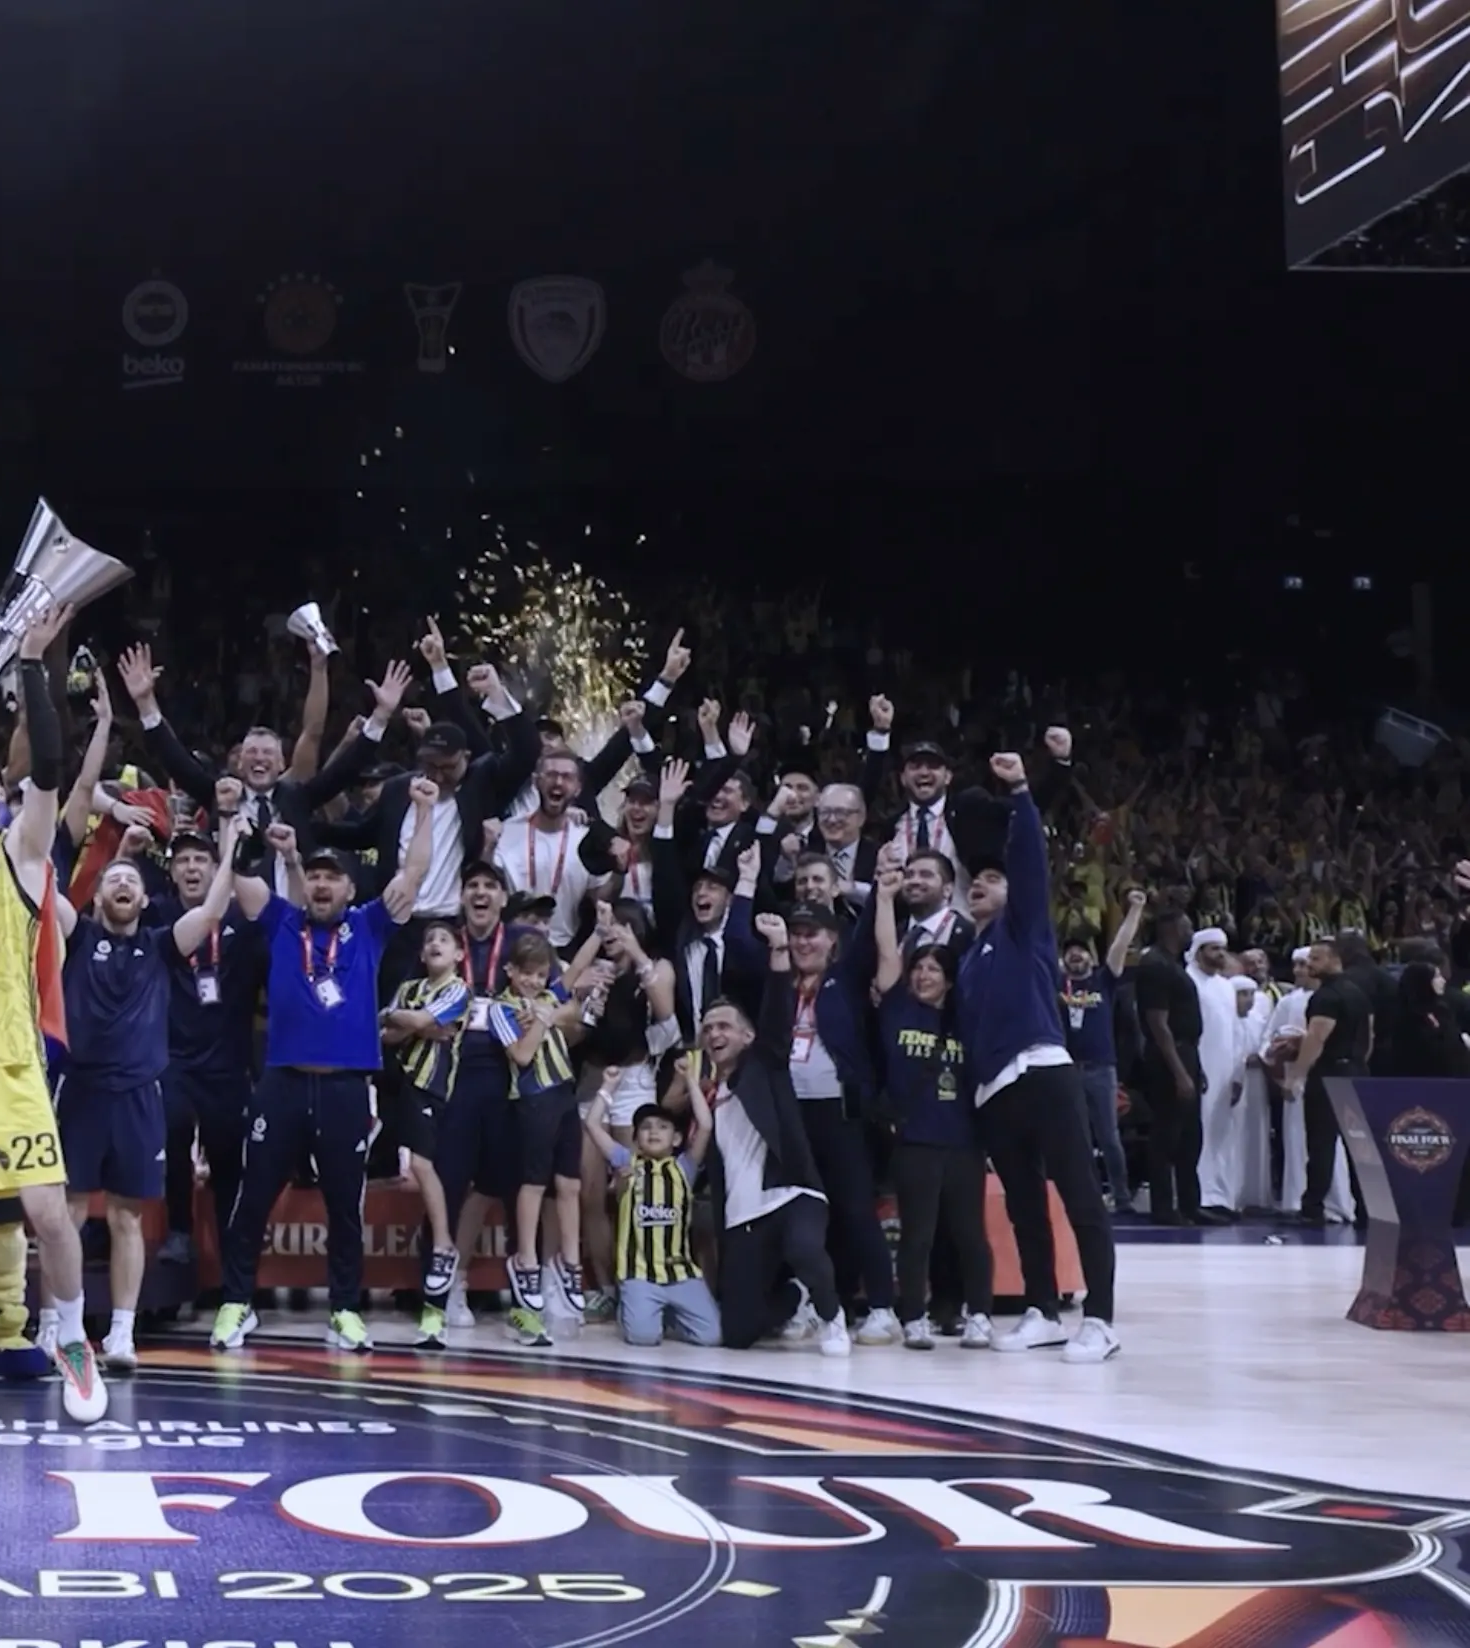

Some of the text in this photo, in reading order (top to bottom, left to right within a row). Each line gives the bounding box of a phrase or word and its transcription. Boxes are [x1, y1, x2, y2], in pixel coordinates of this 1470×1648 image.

[11, 1132, 58, 1170] 23
[638, 1203, 678, 1219] beko
[85, 1420, 397, 1434] AIRLINES
[45, 1471, 1291, 1549] FOUR
[219, 1570, 646, 1602] 2025
